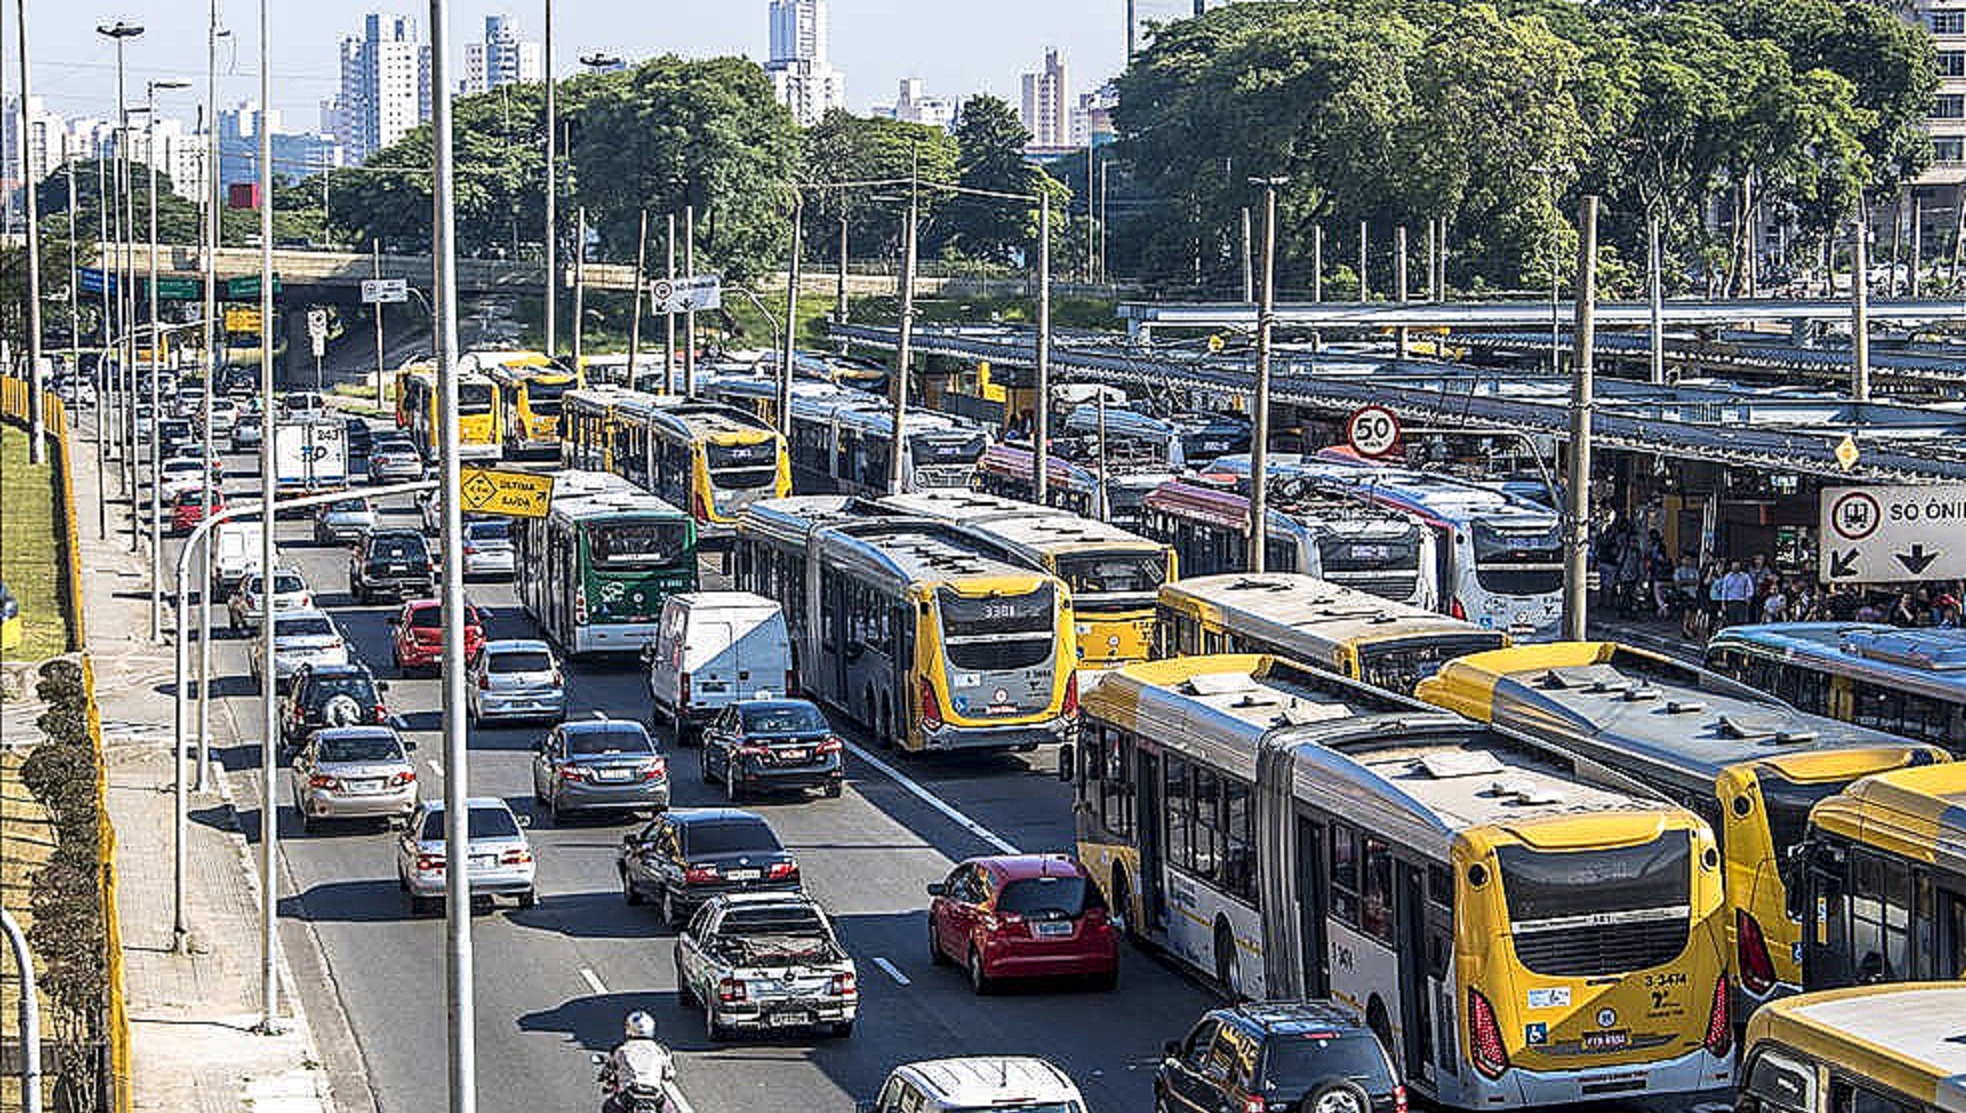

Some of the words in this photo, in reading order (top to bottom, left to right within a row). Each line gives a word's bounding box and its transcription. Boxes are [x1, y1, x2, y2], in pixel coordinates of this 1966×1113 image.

[317, 429, 339, 441] 243
[1356, 417, 1389, 440] 50
[1889, 499, 1920, 521] SÓ
